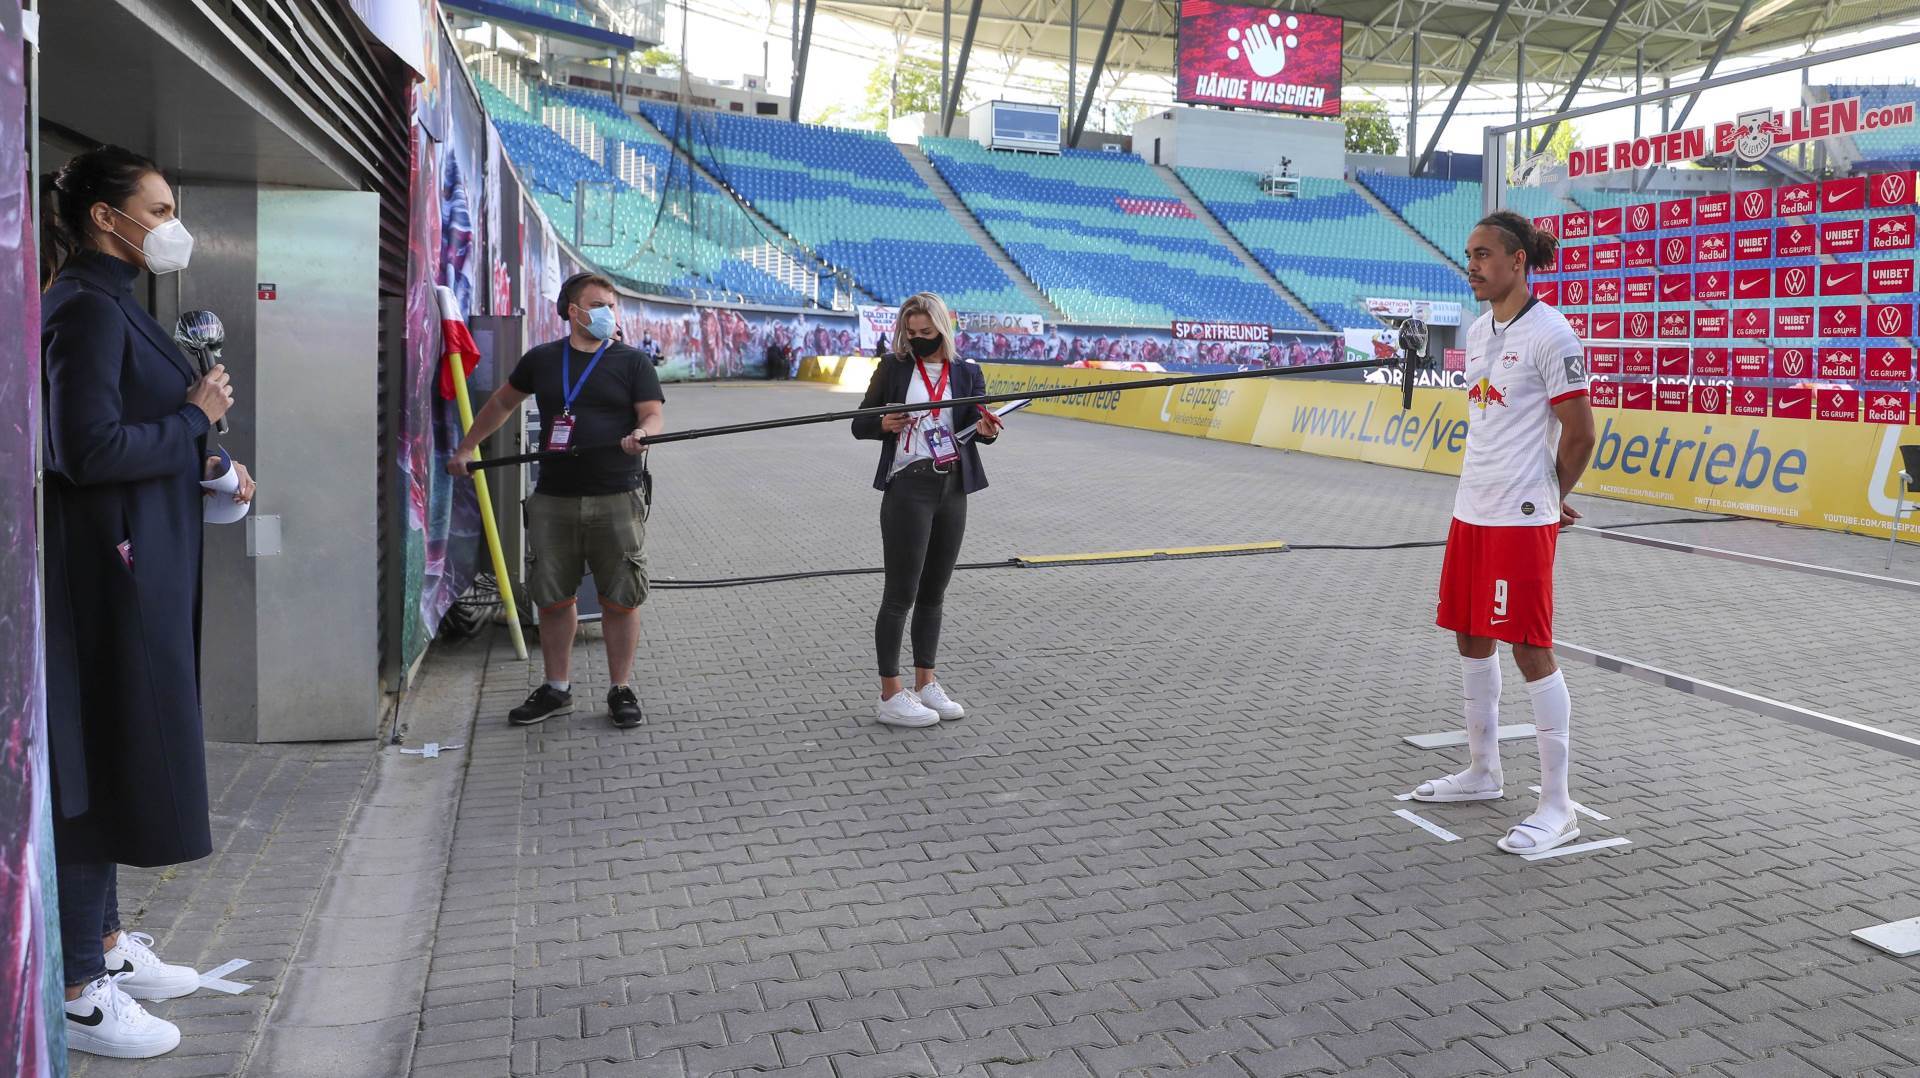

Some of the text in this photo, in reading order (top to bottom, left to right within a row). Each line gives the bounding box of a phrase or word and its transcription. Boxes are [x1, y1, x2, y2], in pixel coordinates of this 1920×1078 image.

[1195, 72, 1325, 108] HÄNDE WASCHEN
[1569, 147, 1608, 177] DIE
[1614, 128, 1704, 170] ROTEN
[1699, 202, 1727, 213] UNIBET
[1670, 218, 1689, 226] GRUPPE
[1825, 229, 1860, 241] UNIBET
[1738, 237, 1768, 248] UNIBET
[1596, 249, 1620, 259] UNIBET
[1789, 245, 1812, 254] GRUPPE
[1635, 257, 1653, 265] GRUPPE
[1873, 268, 1910, 280] UNIBET
[1627, 282, 1651, 291] UNIBET
[1707, 290, 1726, 298] GRUPPE
[1003, 316, 1022, 329] OX
[1697, 317, 1726, 326] UNIBET
[1778, 315, 1810, 325] UNIBET
[1175, 322, 1269, 341] SPORTFREUNDE
[1736, 328, 1766, 336] CG GRUPPE
[1832, 327, 1857, 335] GRUPPE
[1594, 354, 1618, 362] UNIBET
[1736, 355, 1766, 365] UNIBET
[1704, 366, 1725, 374] GRUPPE
[1870, 369, 1907, 377] CG GRUPPE
[1180, 382, 1235, 412] Leipziger
[1659, 390, 1686, 400] UNIBET
[1744, 406, 1764, 414] GRUPPE
[1821, 410, 1855, 419] CG GRUPPE
[1591, 418, 1808, 494] betriebe
[1493, 579, 1508, 616] 9
